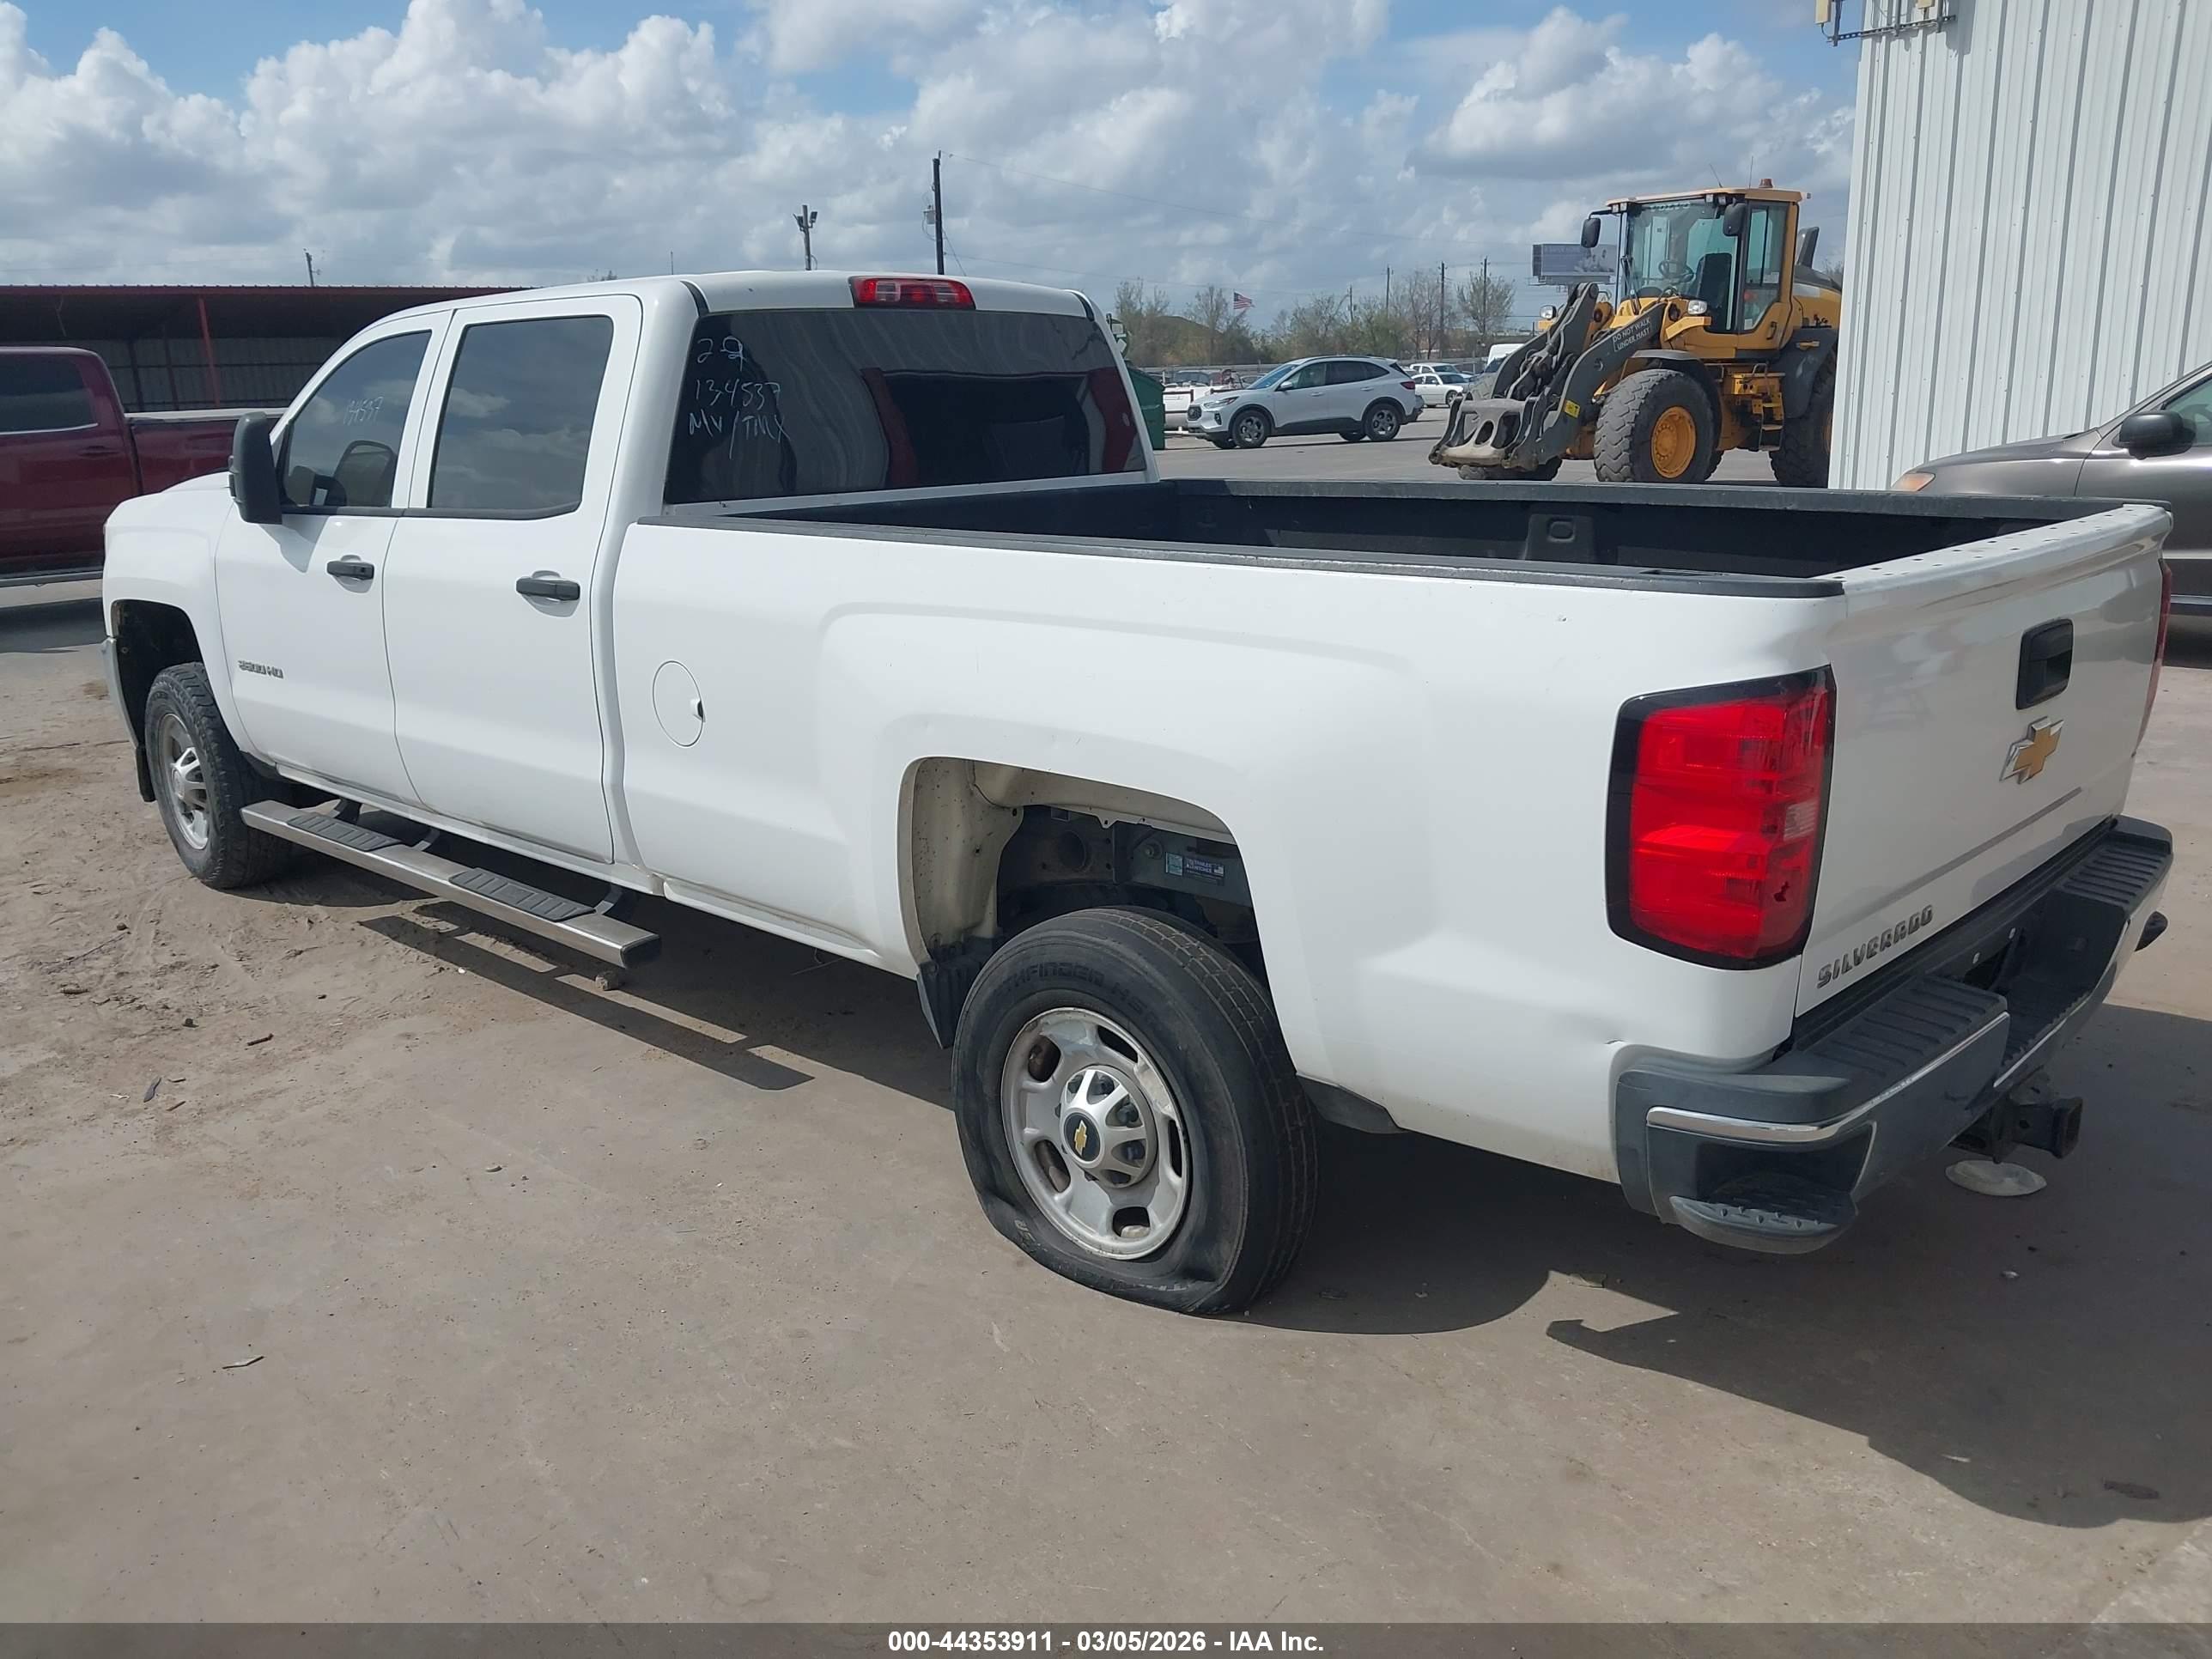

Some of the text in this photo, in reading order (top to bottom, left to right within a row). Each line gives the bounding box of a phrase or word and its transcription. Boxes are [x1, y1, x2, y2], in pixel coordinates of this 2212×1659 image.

[1616, 327, 1650, 351] UNDER MAST
[1622, 327, 1635, 337] NOT
[1634, 317, 1650, 330] WALK
[1816, 904, 1934, 989] SILVERADO
